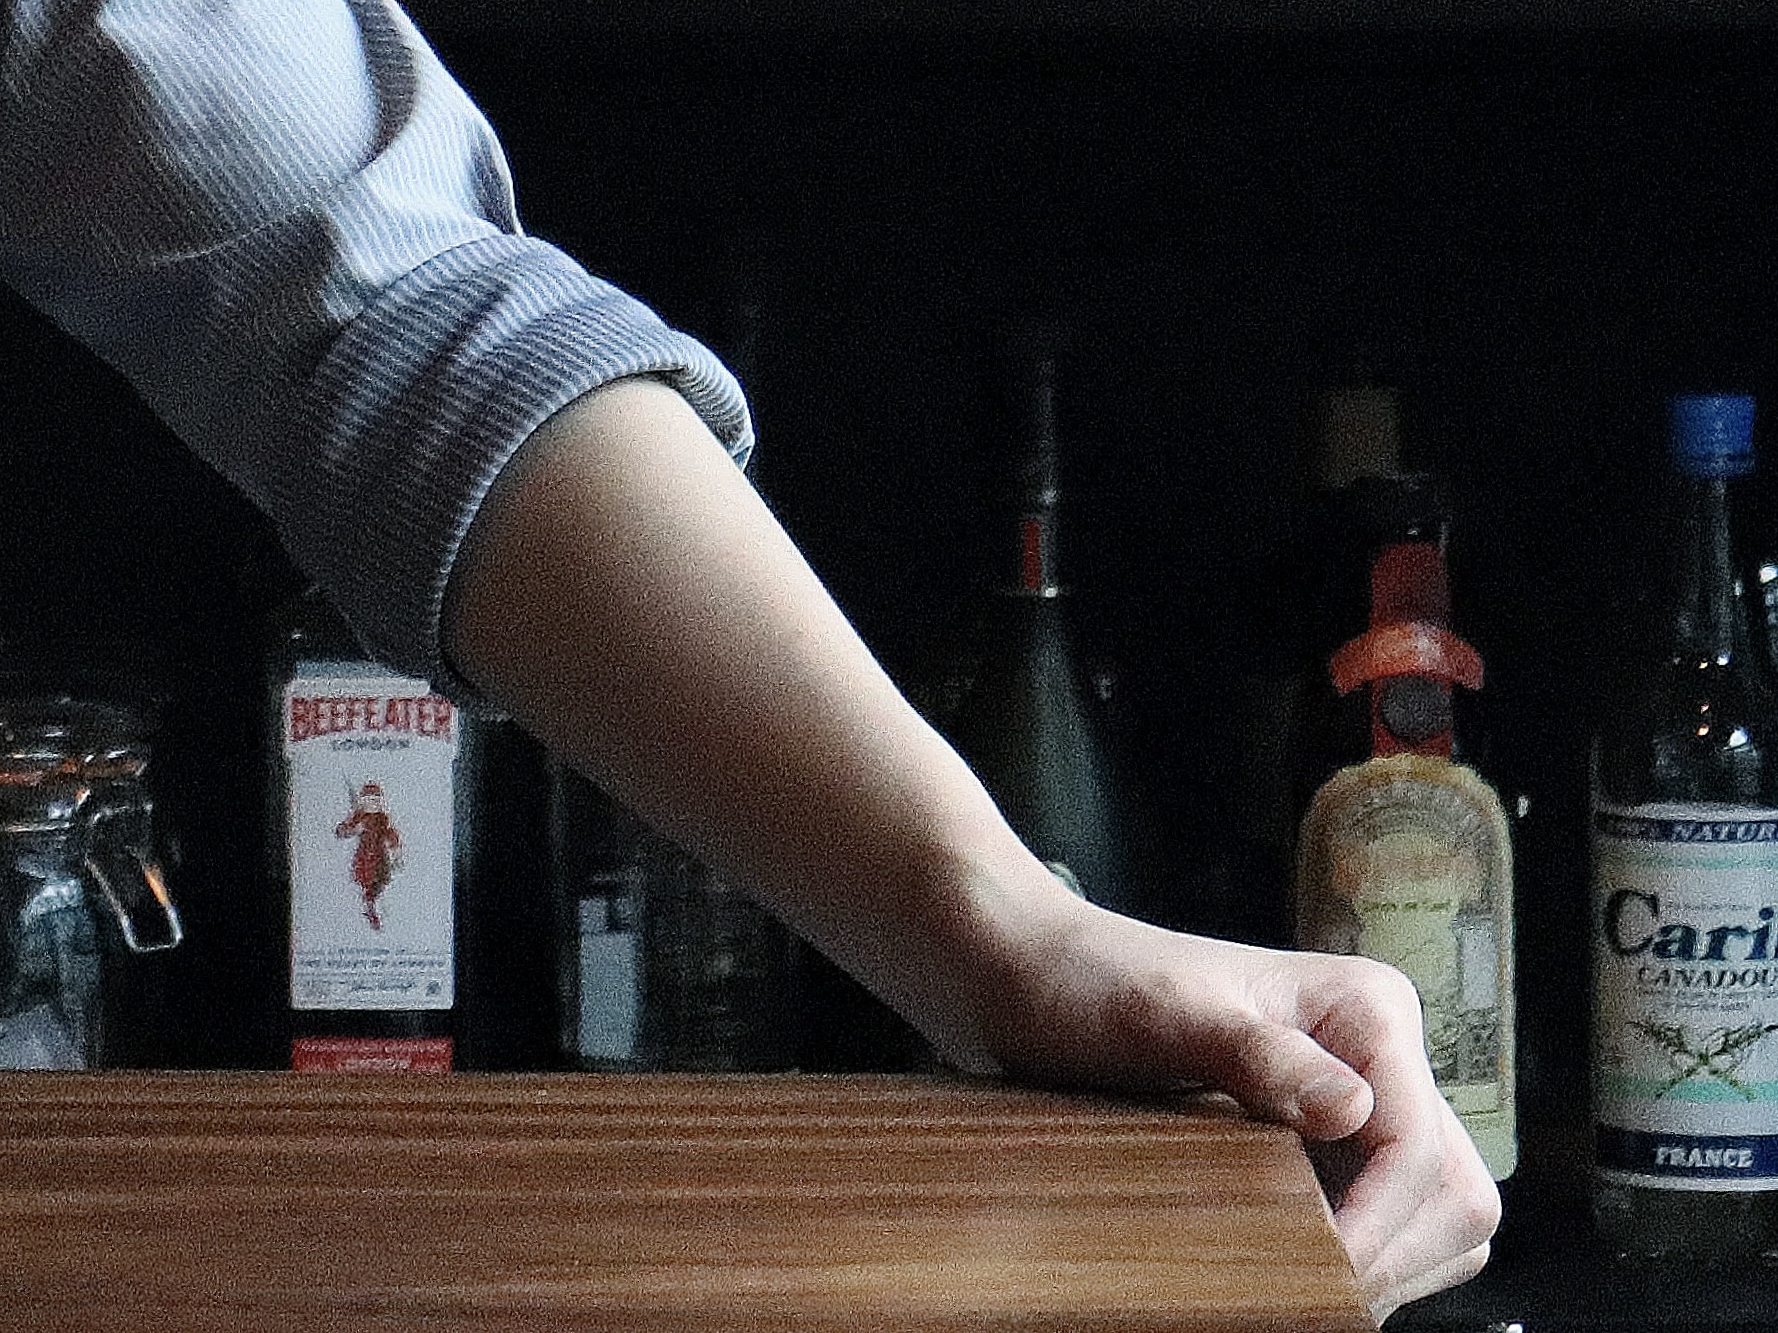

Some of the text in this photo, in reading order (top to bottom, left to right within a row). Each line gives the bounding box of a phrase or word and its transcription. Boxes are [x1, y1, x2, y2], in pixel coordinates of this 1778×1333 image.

[291, 696, 453, 745] BEEFEATER
[1605, 889, 1778, 961] Cari
[1653, 1144, 1754, 1170] FRANCE
